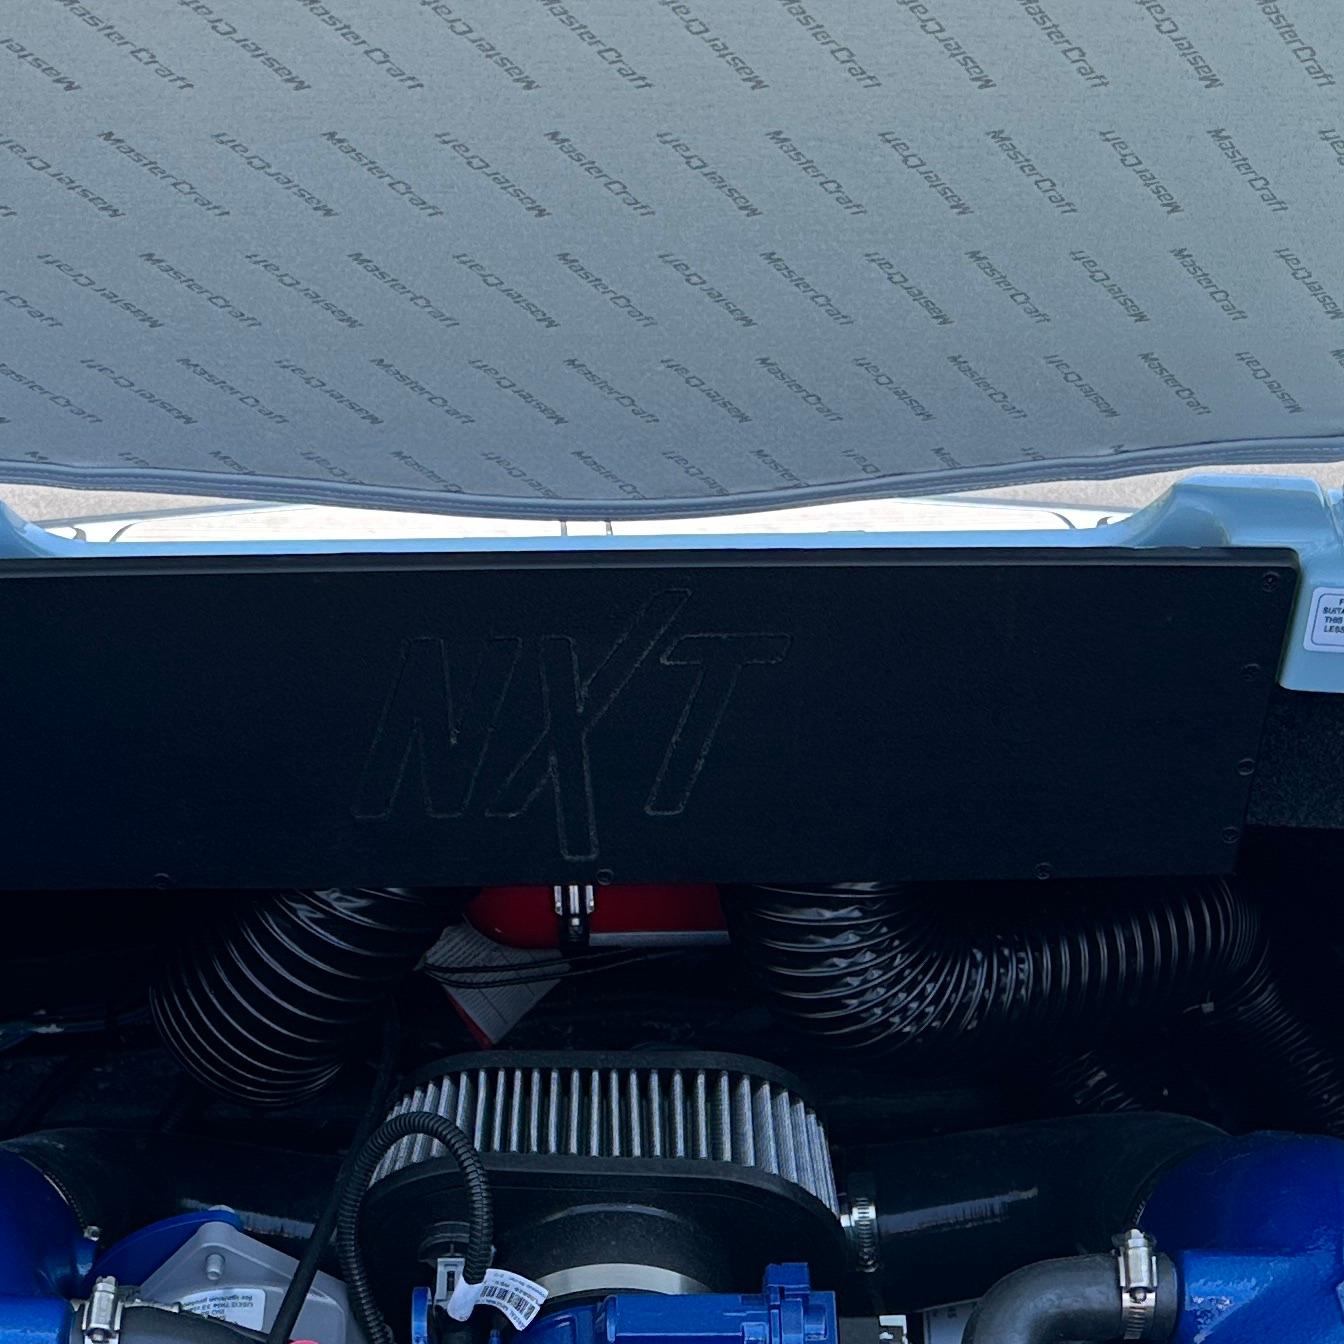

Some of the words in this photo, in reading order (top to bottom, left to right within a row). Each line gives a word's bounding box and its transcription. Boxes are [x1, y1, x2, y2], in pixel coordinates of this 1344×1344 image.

[98, 130, 232, 217] MasterCraft
[210, 132, 339, 218] MasterCraft
[321, 130, 444, 217] MasterCraft
[435, 132, 552, 218] MasterCraft
[543, 130, 655, 217] MasterCraft
[657, 132, 762, 218] MasterCraft
[765, 130, 868, 216] MasterCraft
[878, 130, 975, 217] MasterCraft
[985, 129, 1077, 215] MasterCraft
[1099, 130, 1184, 217] MasterCraft
[1207, 128, 1289, 213] MasterCraft
[36, 254, 164, 328] MasterCraft
[139, 252, 262, 328] MasterCraft
[244, 253, 364, 328] MasterCraft
[347, 252, 460, 327] MasterCraft
[452, 253, 560, 329] MasterCraft
[557, 252, 657, 327] MasterCraft
[658, 252, 757, 327] MasterCraft
[761, 251, 854, 326] MasterCraft
[864, 251, 954, 326] MasterCraft
[966, 249, 1051, 324] MasterCraft
[1069, 250, 1151, 323] MasterCraft
[1170, 247, 1248, 322] MasterCraft
[176, 358, 290, 425] MasterCraft
[370, 357, 476, 425] MasterCraft
[563, 357, 661, 424] MasterCraft
[757, 356, 844, 422] MasterCraft
[947, 354, 1028, 420] MasterCraft
[1139, 351, 1211, 416] MasterCraft
[1324, 616, 1343, 624] THIS
[1324, 625, 1344, 633] LESS
